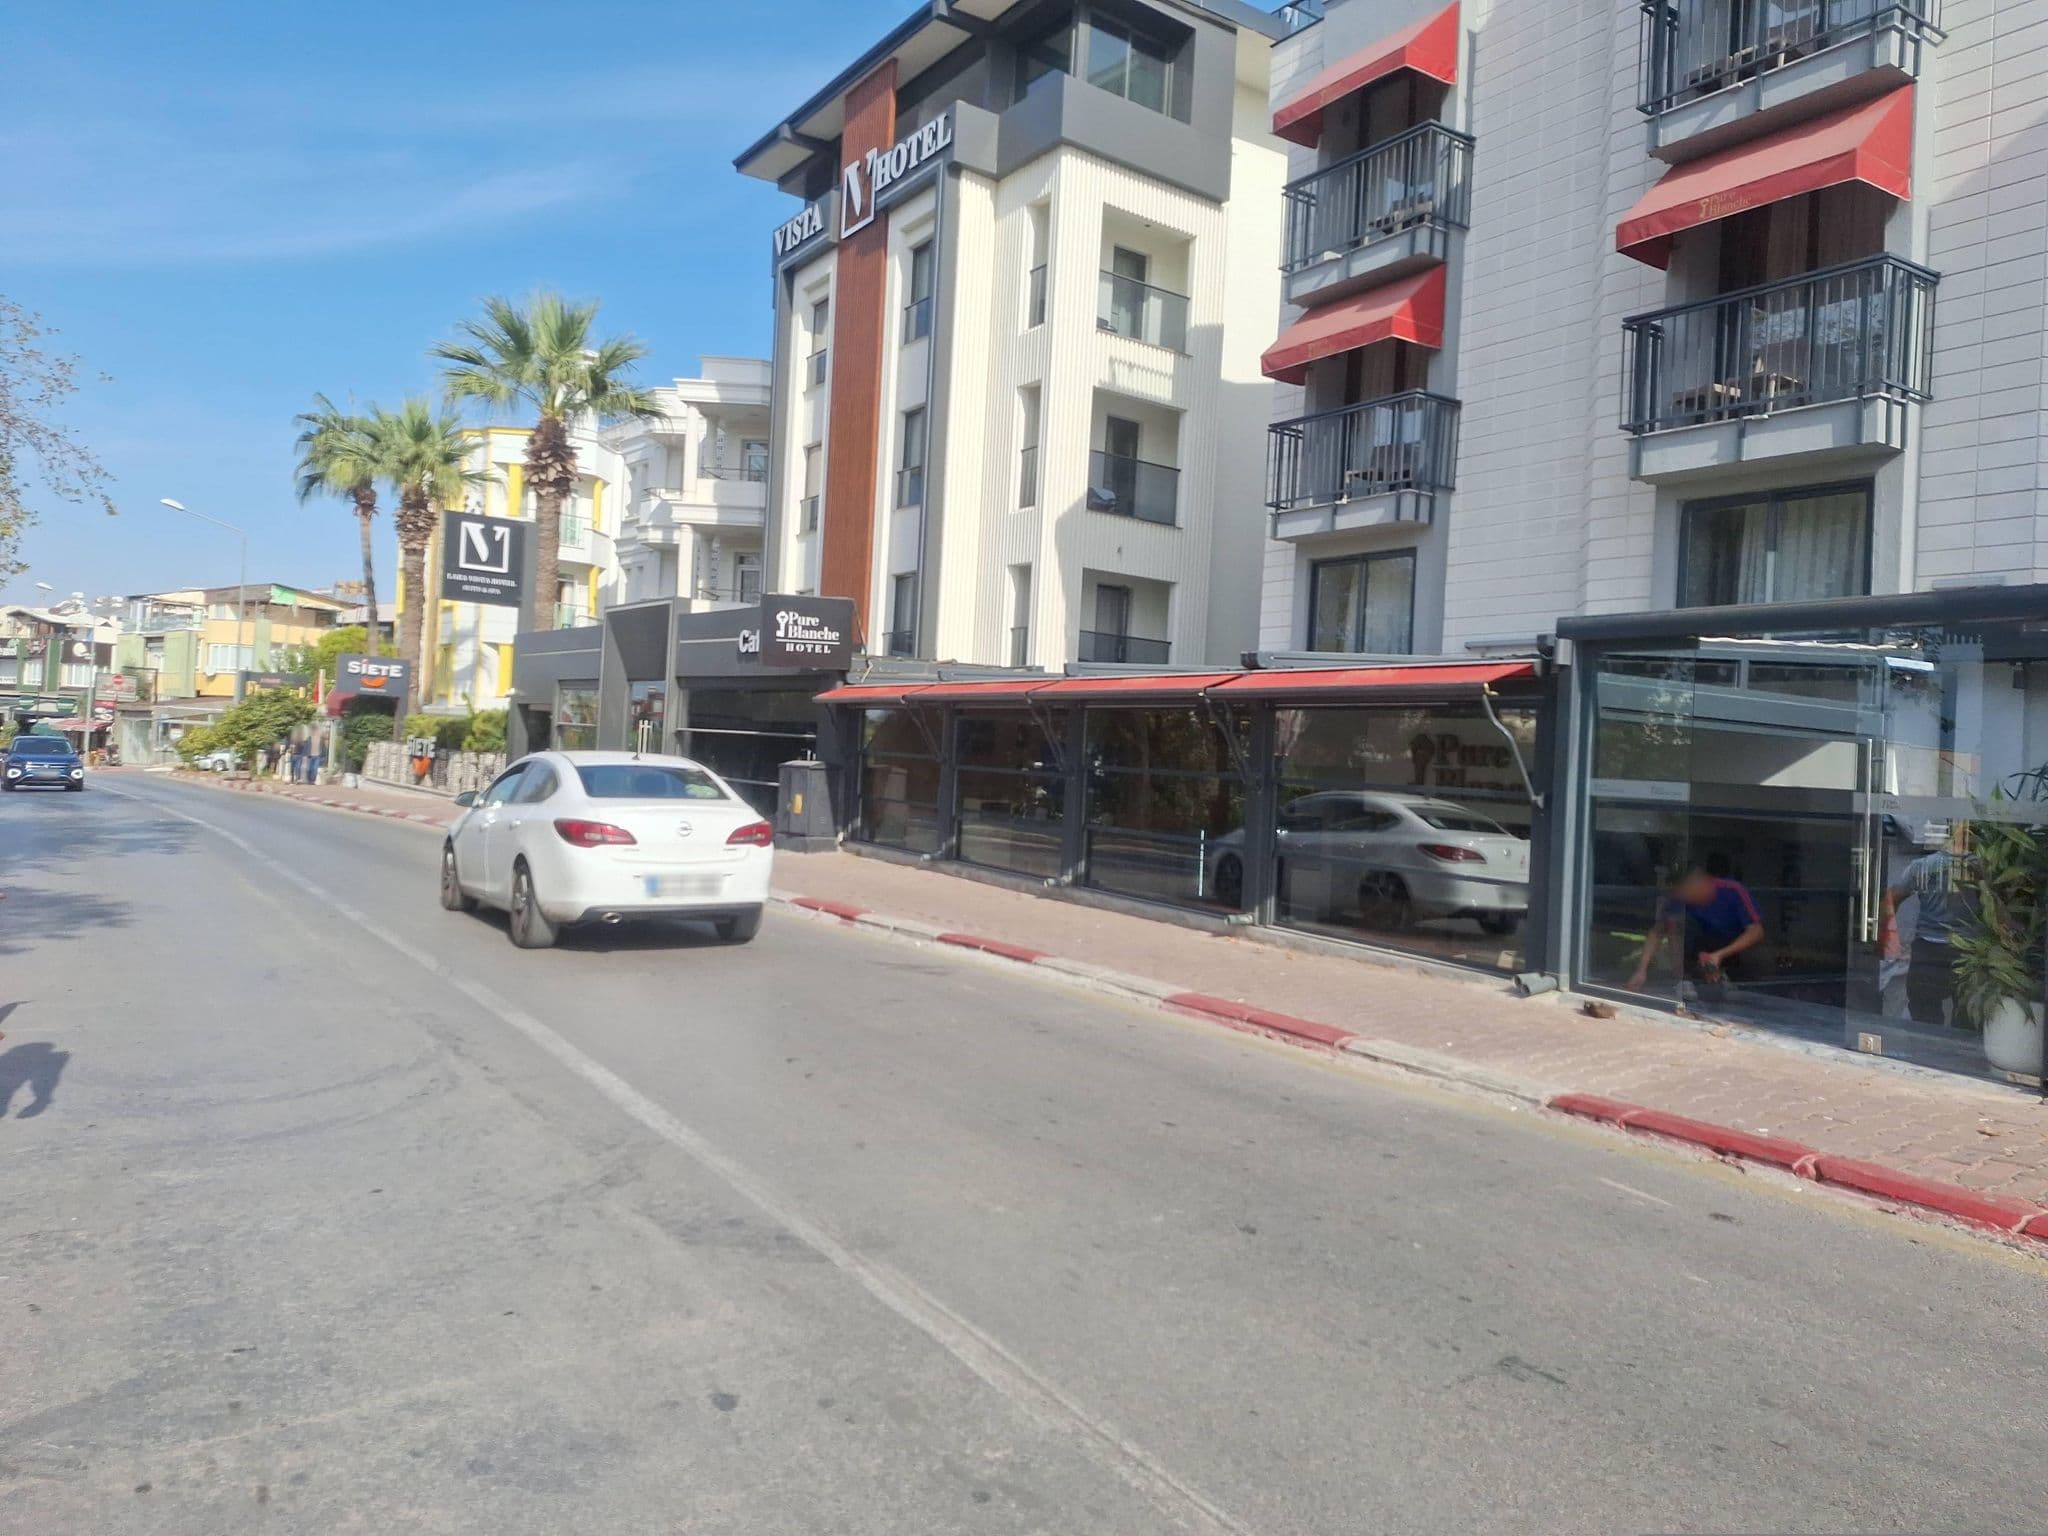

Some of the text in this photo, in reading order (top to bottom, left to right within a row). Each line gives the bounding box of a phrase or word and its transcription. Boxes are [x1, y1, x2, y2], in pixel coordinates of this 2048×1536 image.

[774, 203, 823, 257] VISTA
[875, 113, 952, 191] HOTEL
[788, 611, 820, 626] Pure
[788, 625, 840, 641] Blanche
[785, 643, 831, 654] HOTEL
